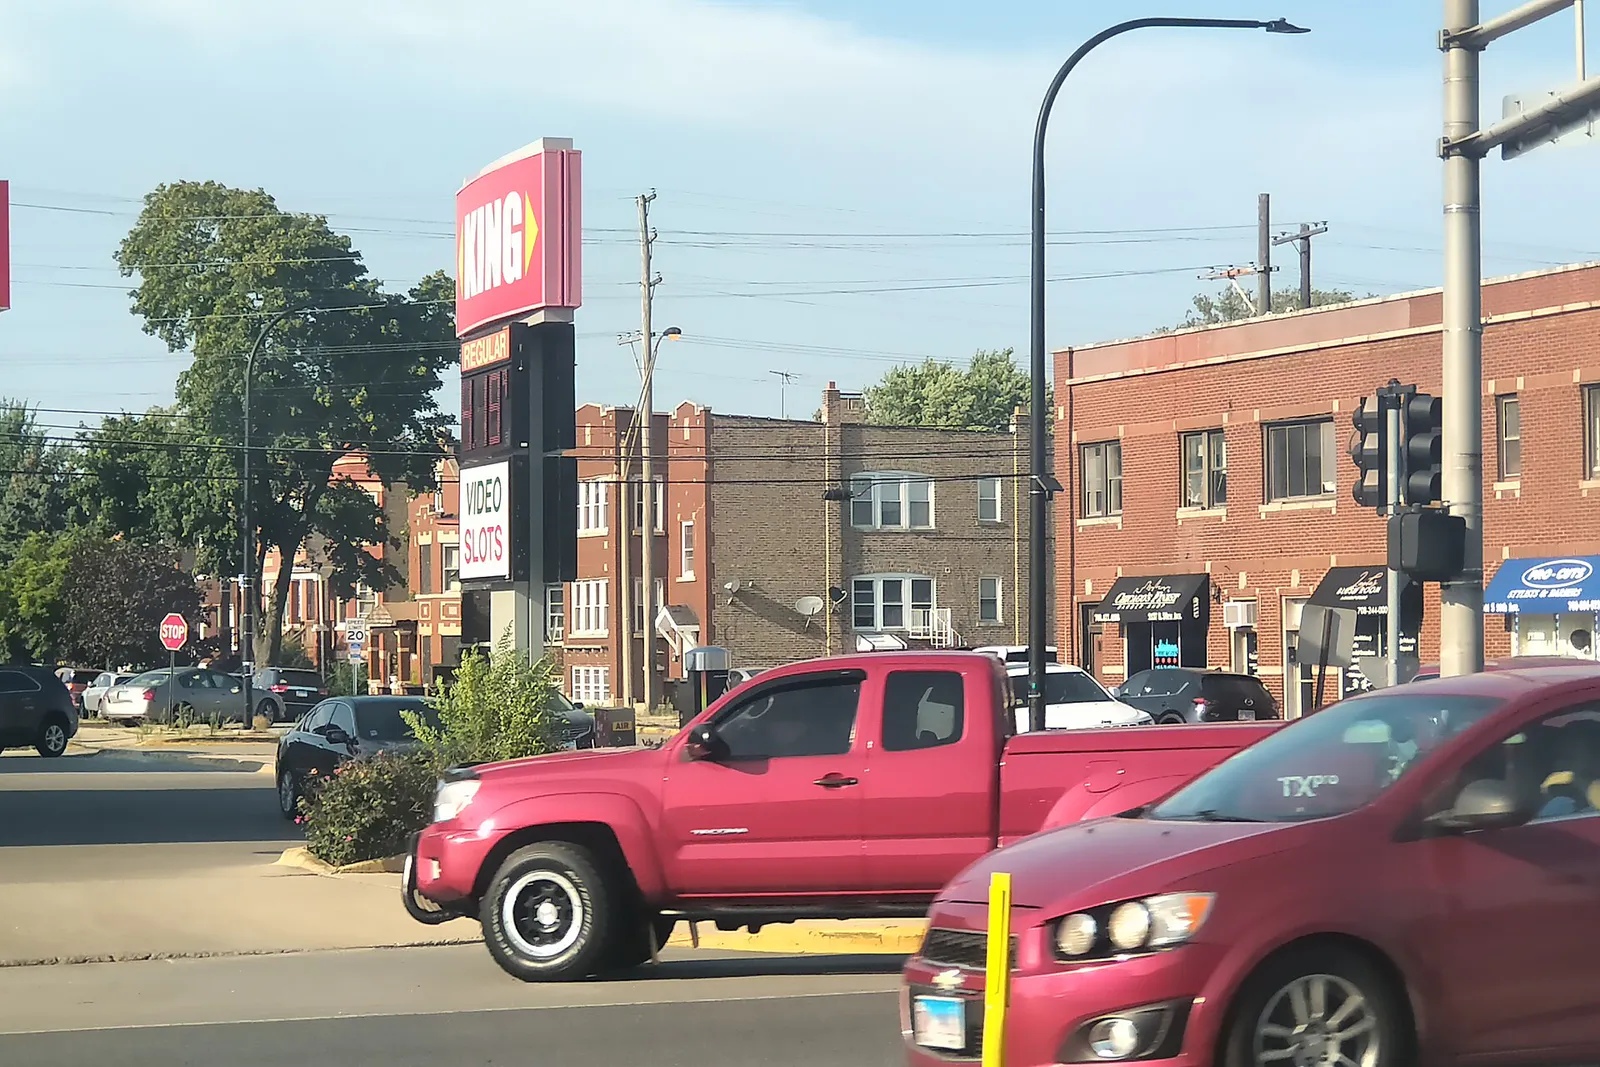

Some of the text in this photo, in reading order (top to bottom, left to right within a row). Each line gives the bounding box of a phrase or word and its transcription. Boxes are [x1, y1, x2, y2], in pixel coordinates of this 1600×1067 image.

[464, 190, 522, 300] KING
[462, 336, 508, 372] REGULAR
[466, 476, 502, 516] VIDEO
[464, 524, 503, 565] SLOTS
[1527, 567, 1587, 581] PRO-CUTS
[1357, 605, 1388, 615] 708-344-000
[162, 624, 185, 639] STOP
[347, 630, 364, 641] 20
[615, 722, 629, 730] AIR
